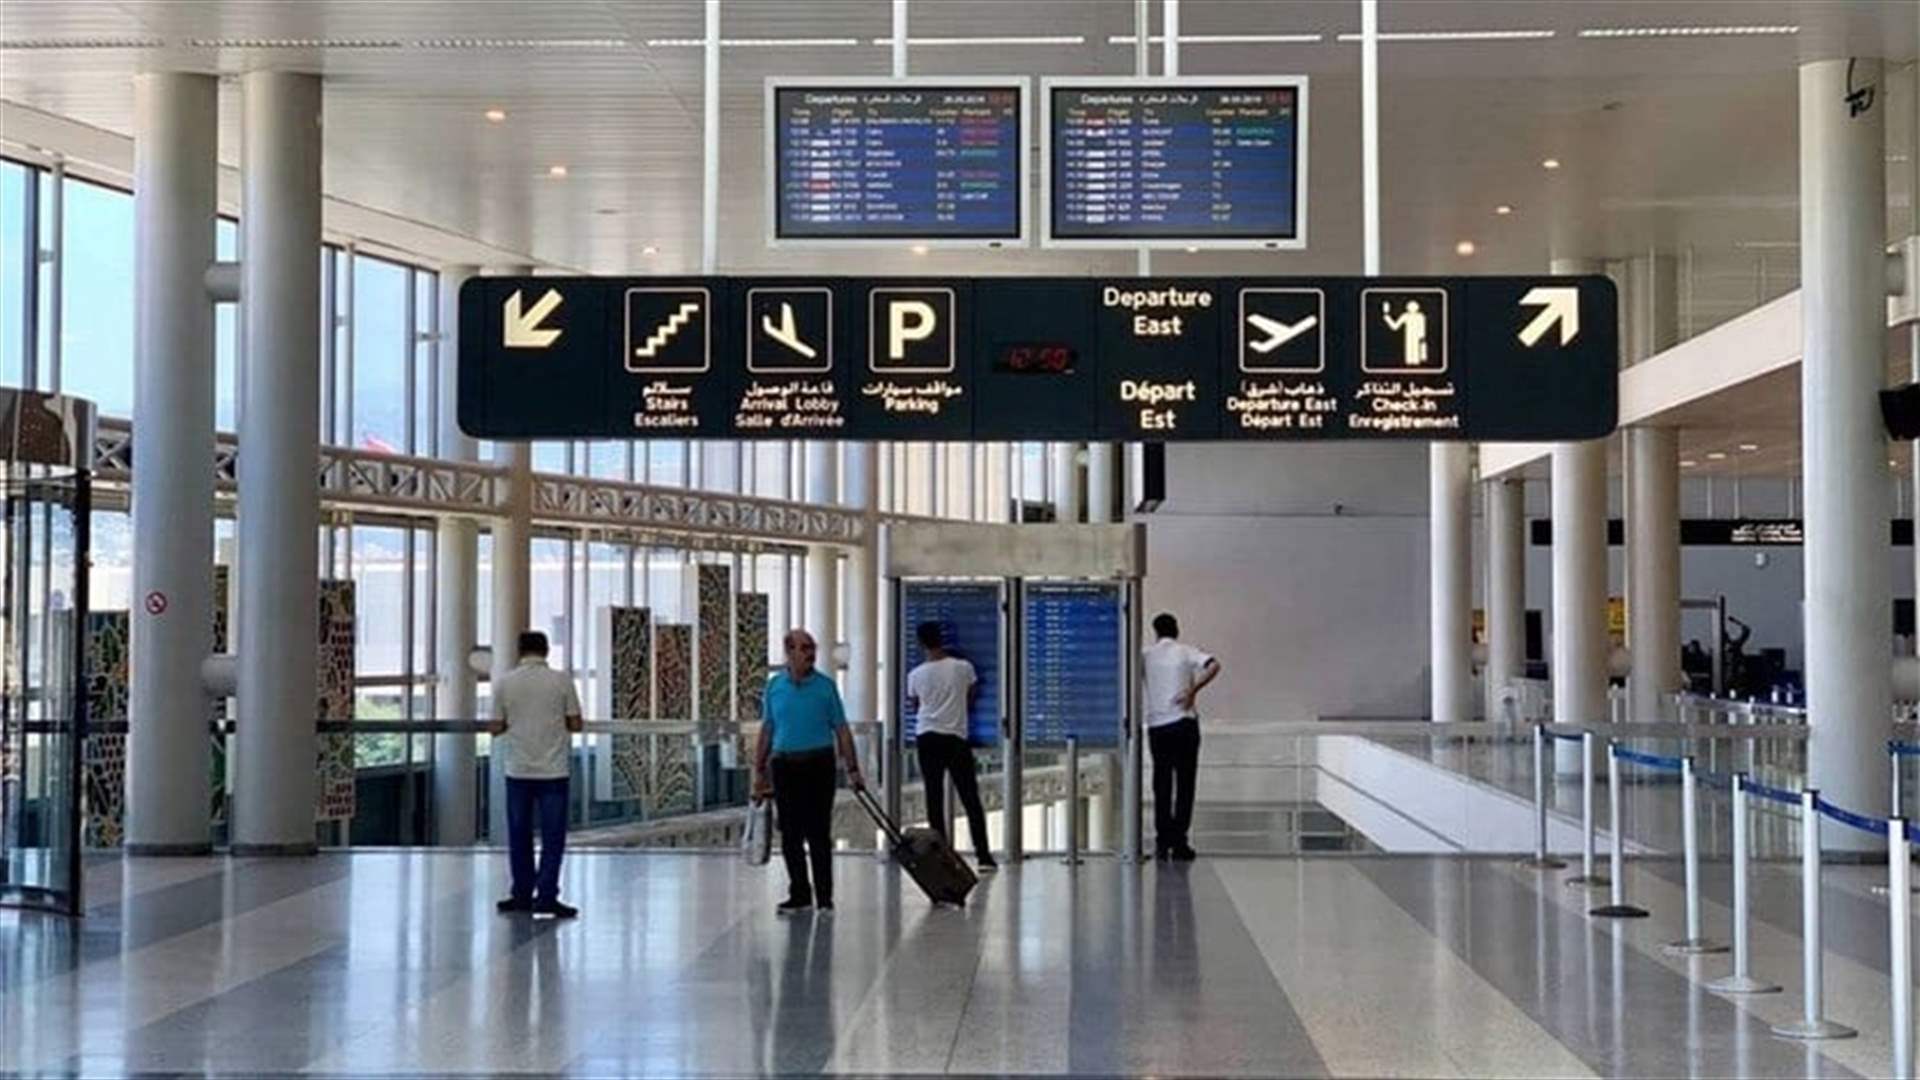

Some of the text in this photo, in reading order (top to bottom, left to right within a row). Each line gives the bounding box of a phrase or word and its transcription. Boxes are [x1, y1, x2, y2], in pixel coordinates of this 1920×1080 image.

[1103, 287, 1212, 311] Departure
[889, 301, 936, 359] P
[1133, 315, 1183, 336] East
[1120, 380, 1196, 405] Départ
[645, 397, 688, 411] Stairs
[741, 397, 839, 413] Arrival Lobby
[885, 397, 939, 414] Parking
[1226, 396, 1337, 412] Departure East
[634, 412, 699, 427] Escaliers
[735, 413, 773, 427] Salle
[1140, 409, 1177, 429] Est
[1241, 412, 1322, 430] Départ Est
[1348, 413, 1460, 431] Enregistrement
